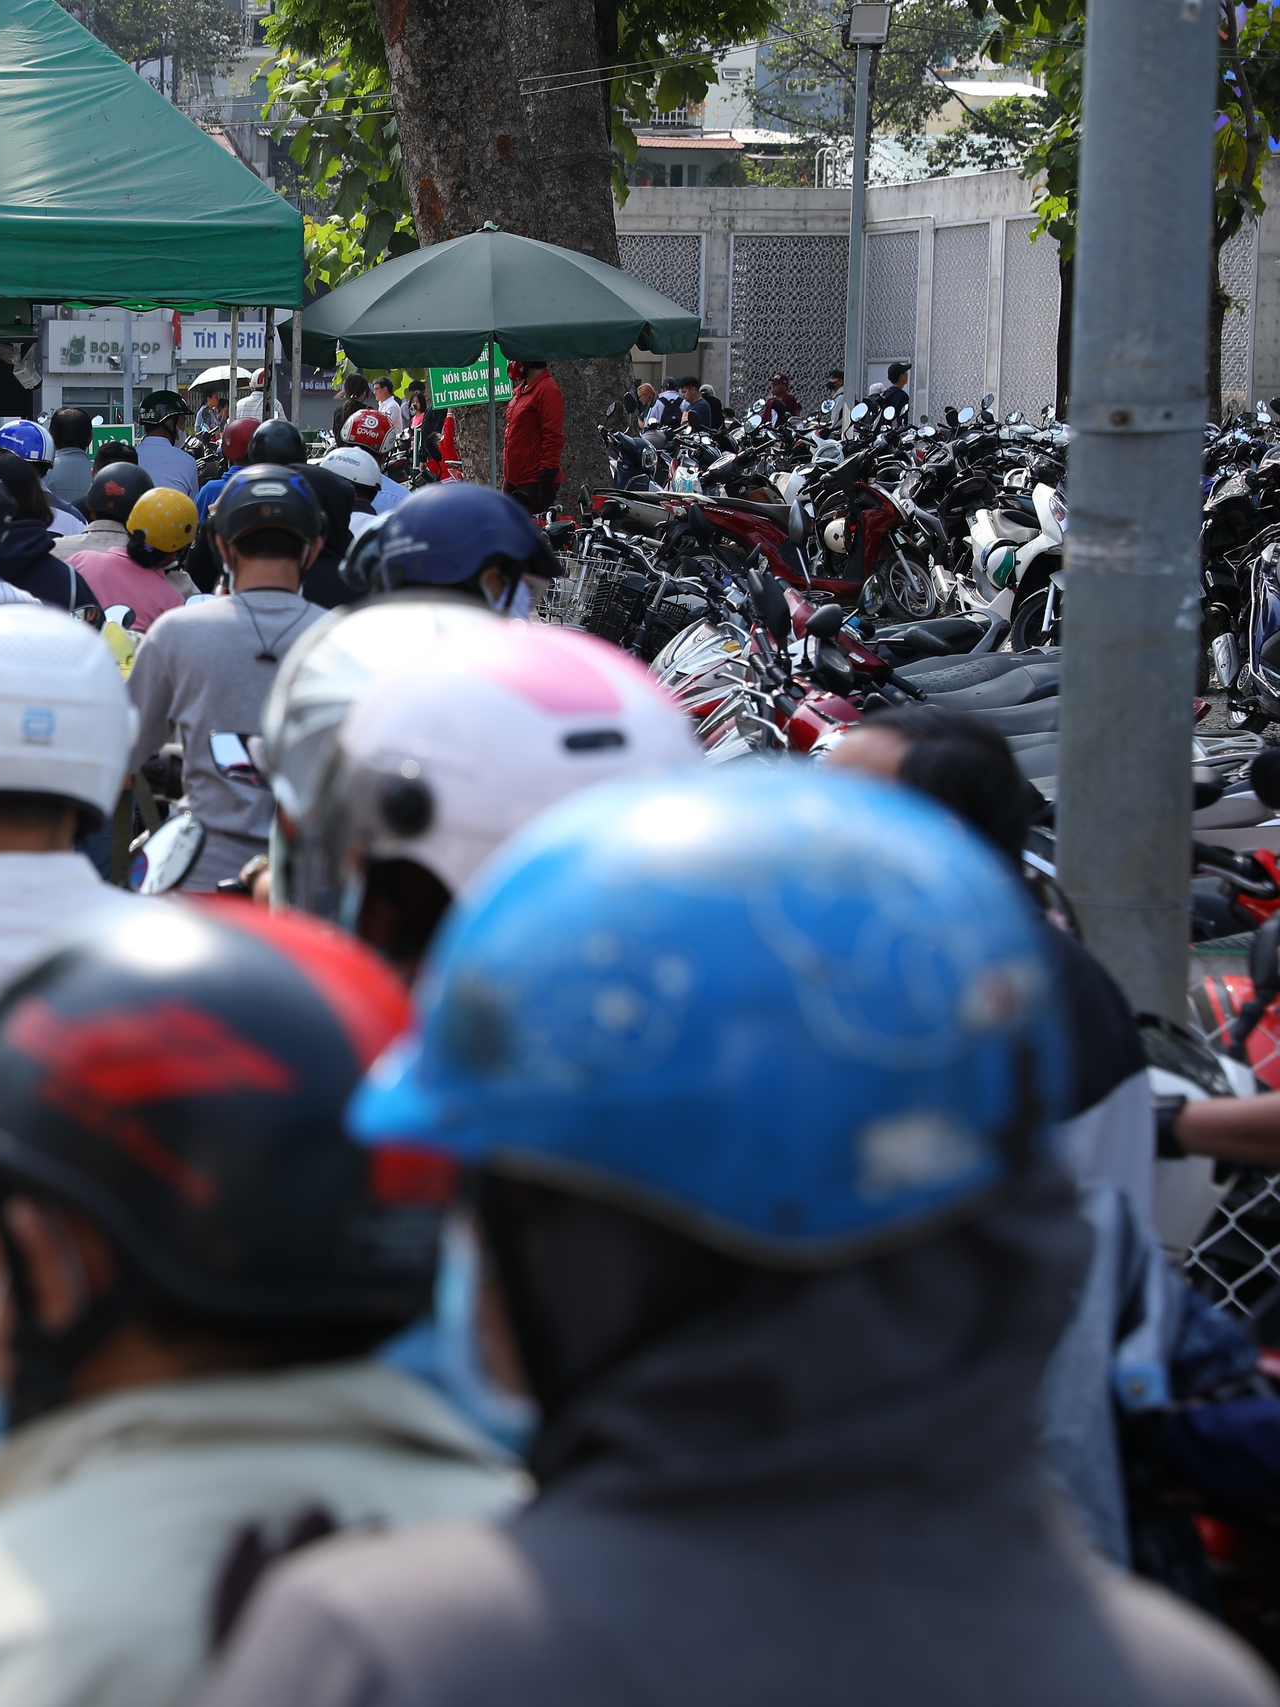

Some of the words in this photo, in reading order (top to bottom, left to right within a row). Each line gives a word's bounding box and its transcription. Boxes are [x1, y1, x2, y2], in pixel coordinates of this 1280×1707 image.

[193, 327, 217, 348] TÍN
[224, 328, 266, 348] NGHÌ
[442, 370, 459, 384] NÓN
[461, 367, 478, 382] BẢO
[480, 367, 501, 380] HIM
[434, 391, 447, 403] TƯ
[448, 388, 476, 402] TRANG
[477, 384, 488, 398] CÁ
[494, 382, 511, 395] HÂN
